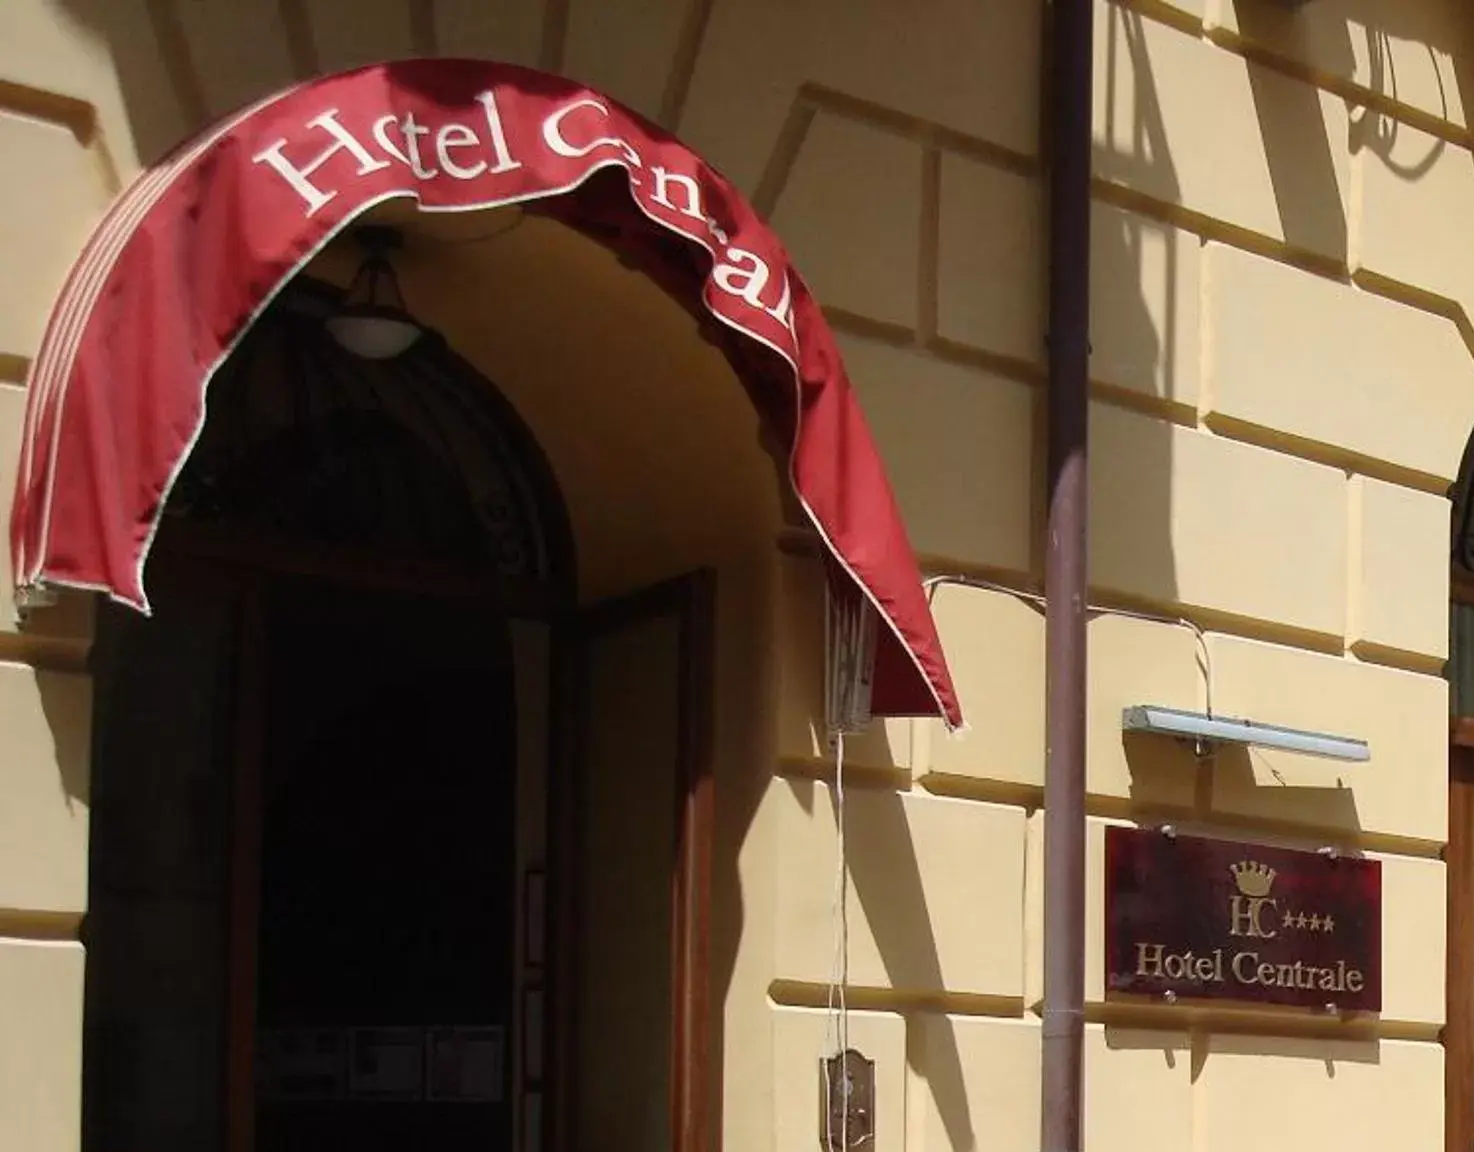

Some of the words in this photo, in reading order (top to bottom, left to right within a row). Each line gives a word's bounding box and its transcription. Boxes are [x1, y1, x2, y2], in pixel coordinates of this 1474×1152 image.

[252, 91, 522, 218] Hotel
[1135, 944, 1223, 981] Hotel
[1231, 952, 1364, 992] Centrale
